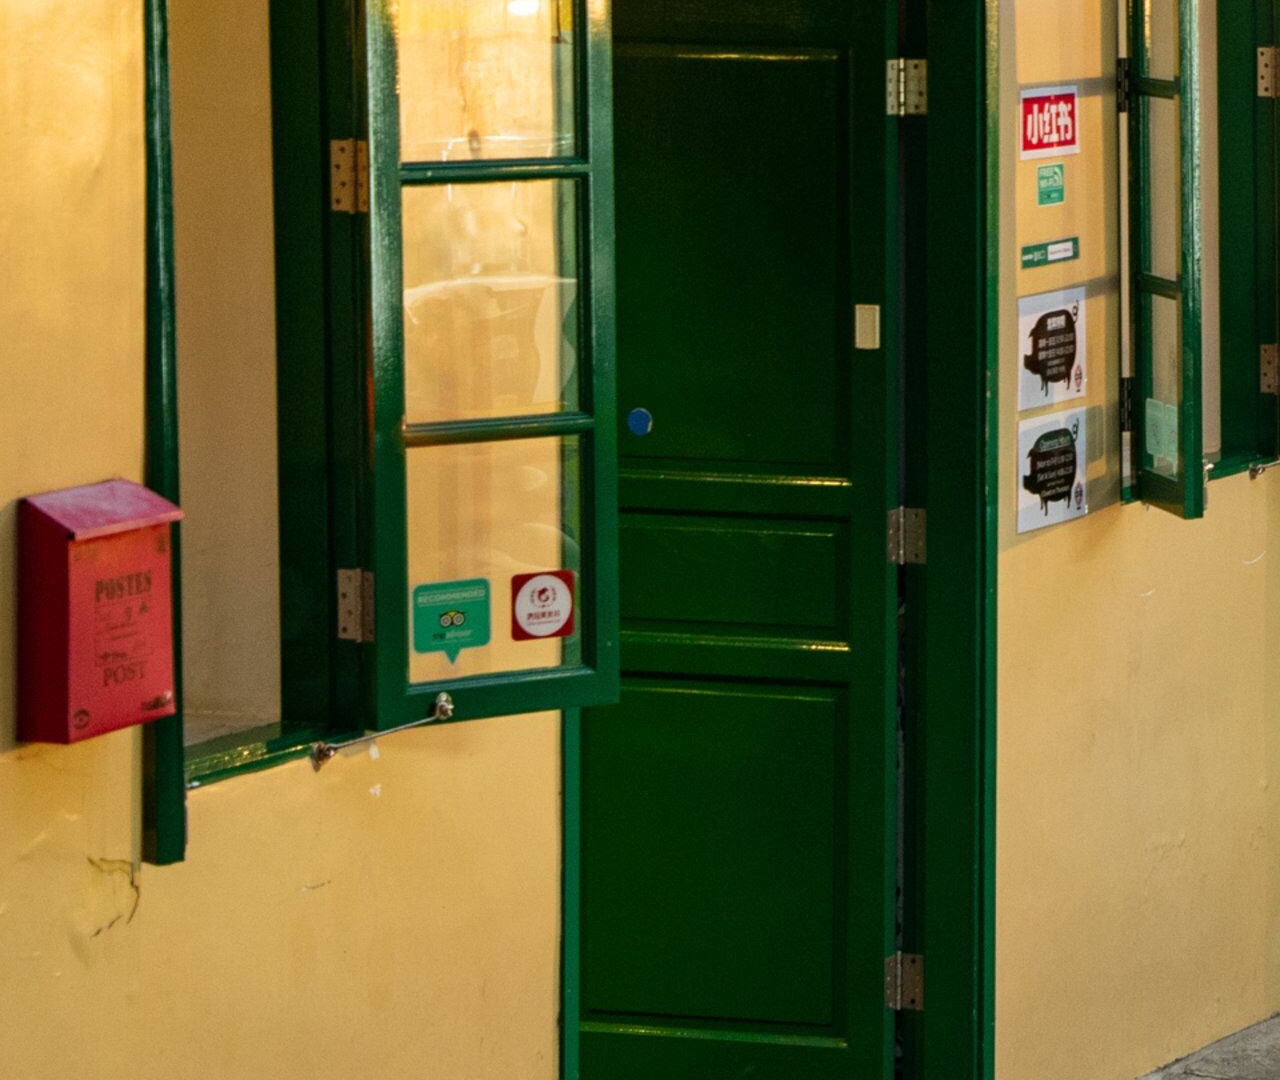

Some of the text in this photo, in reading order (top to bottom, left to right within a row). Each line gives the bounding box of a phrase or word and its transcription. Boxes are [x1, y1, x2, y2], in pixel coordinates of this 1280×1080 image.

[1027, 101, 1072, 145] 小红书
[95, 572, 152, 603] POSTES
[417, 589, 485, 604] RECOMMENDED
[103, 661, 147, 688] POST
